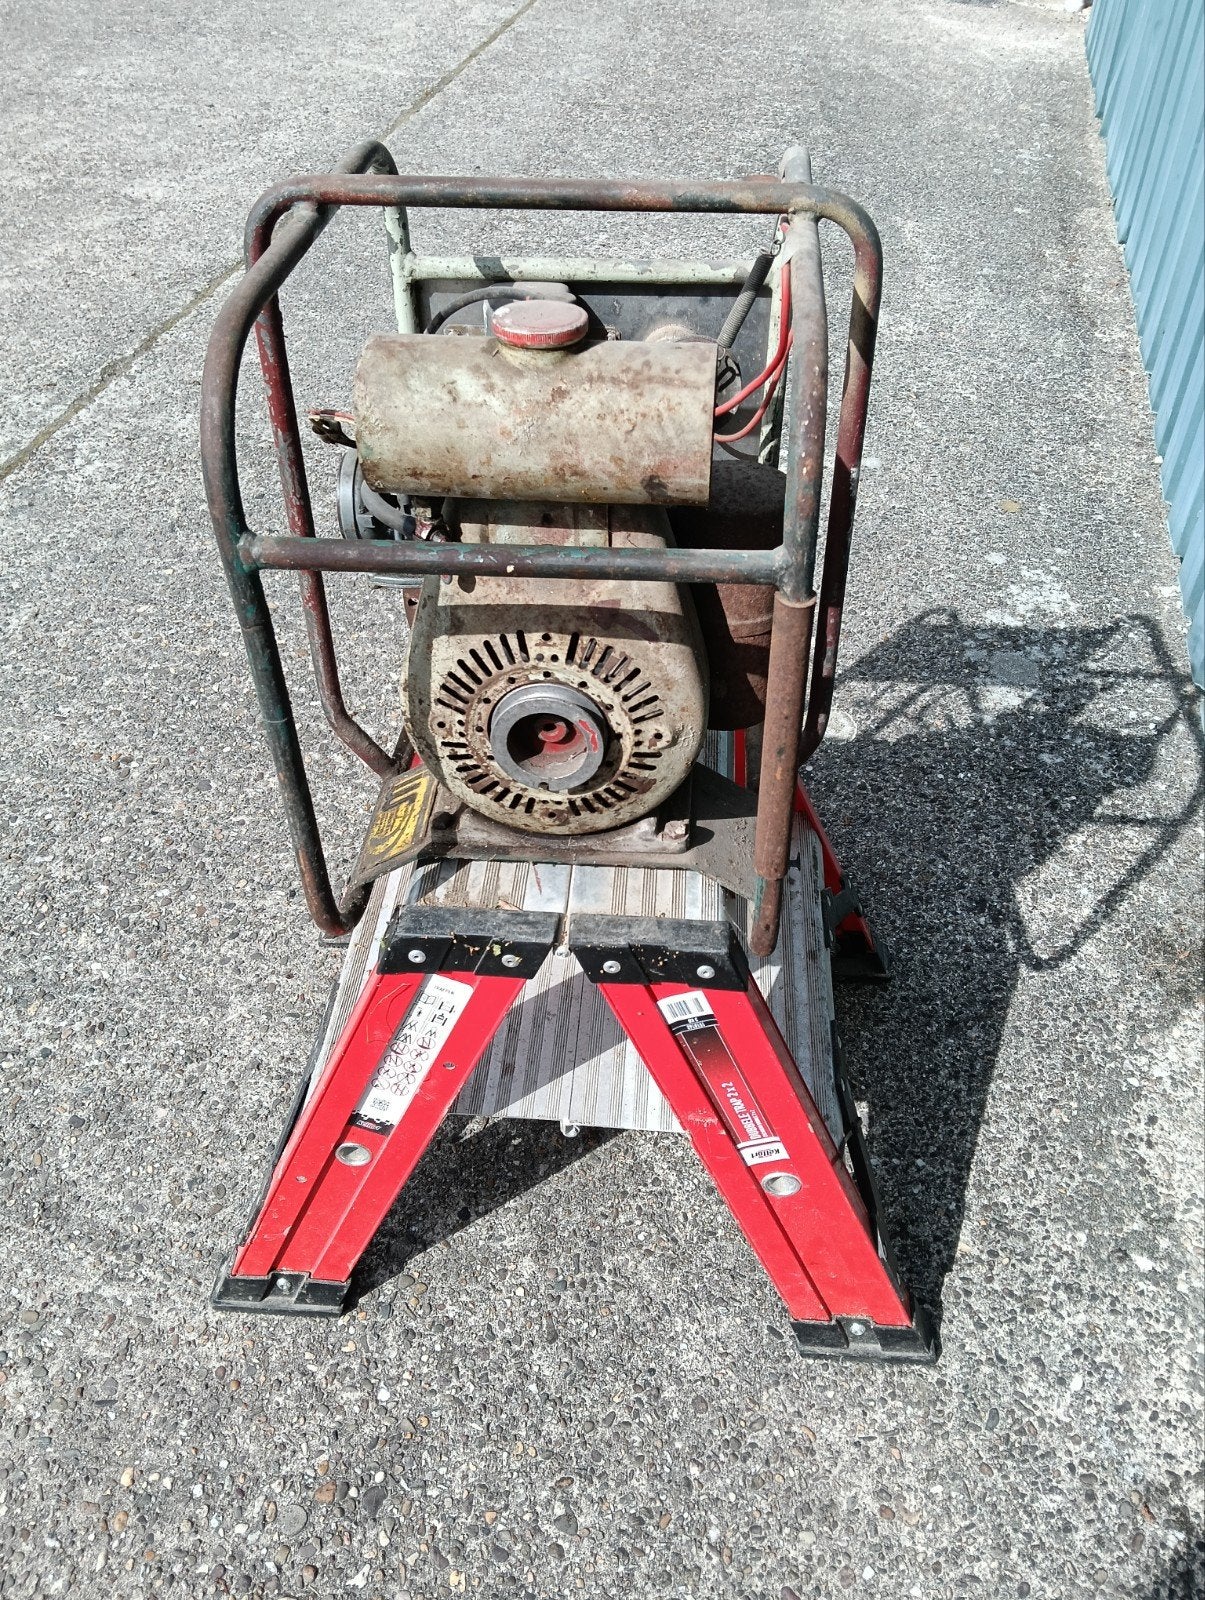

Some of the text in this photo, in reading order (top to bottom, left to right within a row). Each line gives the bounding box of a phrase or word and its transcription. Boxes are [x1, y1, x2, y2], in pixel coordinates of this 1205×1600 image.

[725, 1090, 739, 1098] 2
[728, 1096, 747, 1113] TRAP
[737, 1112, 760, 1139] DUBBELE
